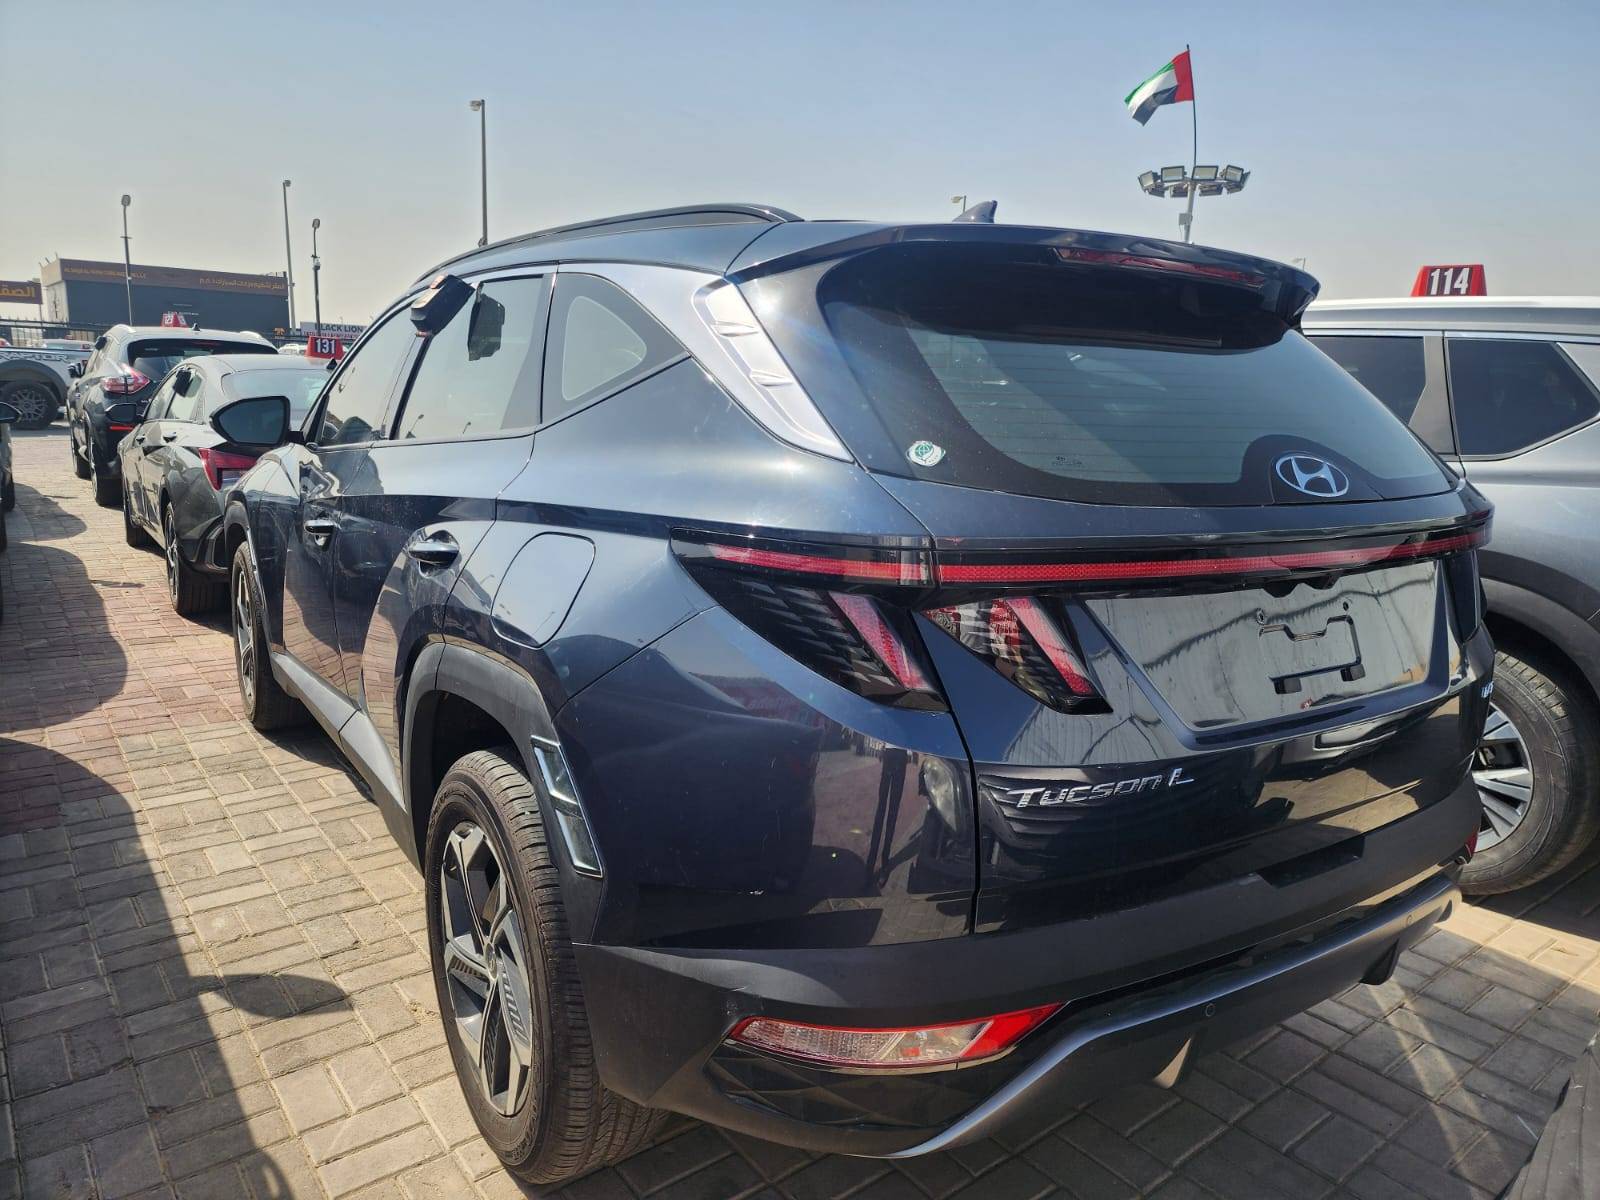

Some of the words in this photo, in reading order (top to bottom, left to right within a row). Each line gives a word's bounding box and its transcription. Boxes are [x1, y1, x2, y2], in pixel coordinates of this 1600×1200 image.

[1430, 267, 1470, 295] 114
[344, 325, 364, 333] LION
[315, 338, 335, 354] 131
[1007, 774, 1163, 808] TUCSON
